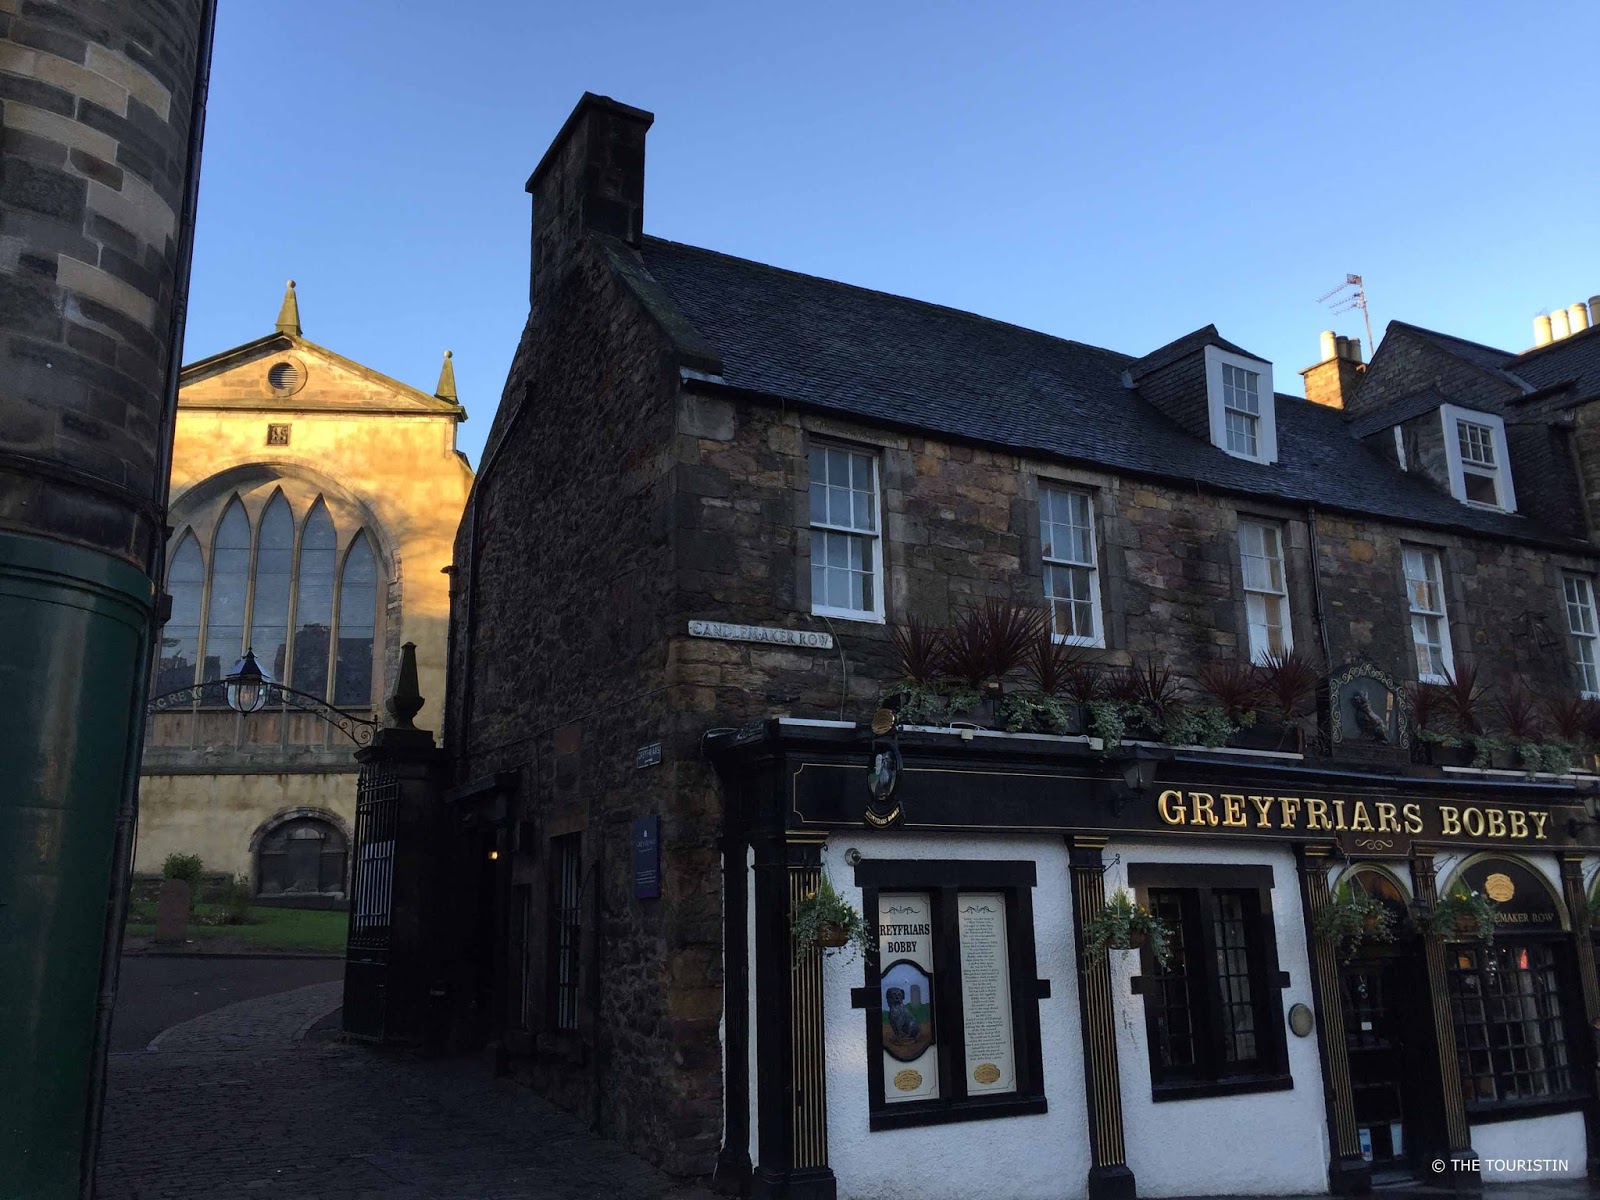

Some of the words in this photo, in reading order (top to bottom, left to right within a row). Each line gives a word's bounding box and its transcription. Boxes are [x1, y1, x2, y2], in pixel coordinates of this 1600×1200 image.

[692, 622, 795, 644] CANDLEMAKER
[799, 632, 830, 647] ROW
[1157, 789, 1424, 835] GREYFRIARS
[1438, 805, 1549, 839] BOBBY
[1494, 912, 1529, 923] EMAKER
[1532, 912, 1554, 923] ROW
[879, 923, 931, 936] REYFRIARS
[887, 941, 918, 953] BOBBY
